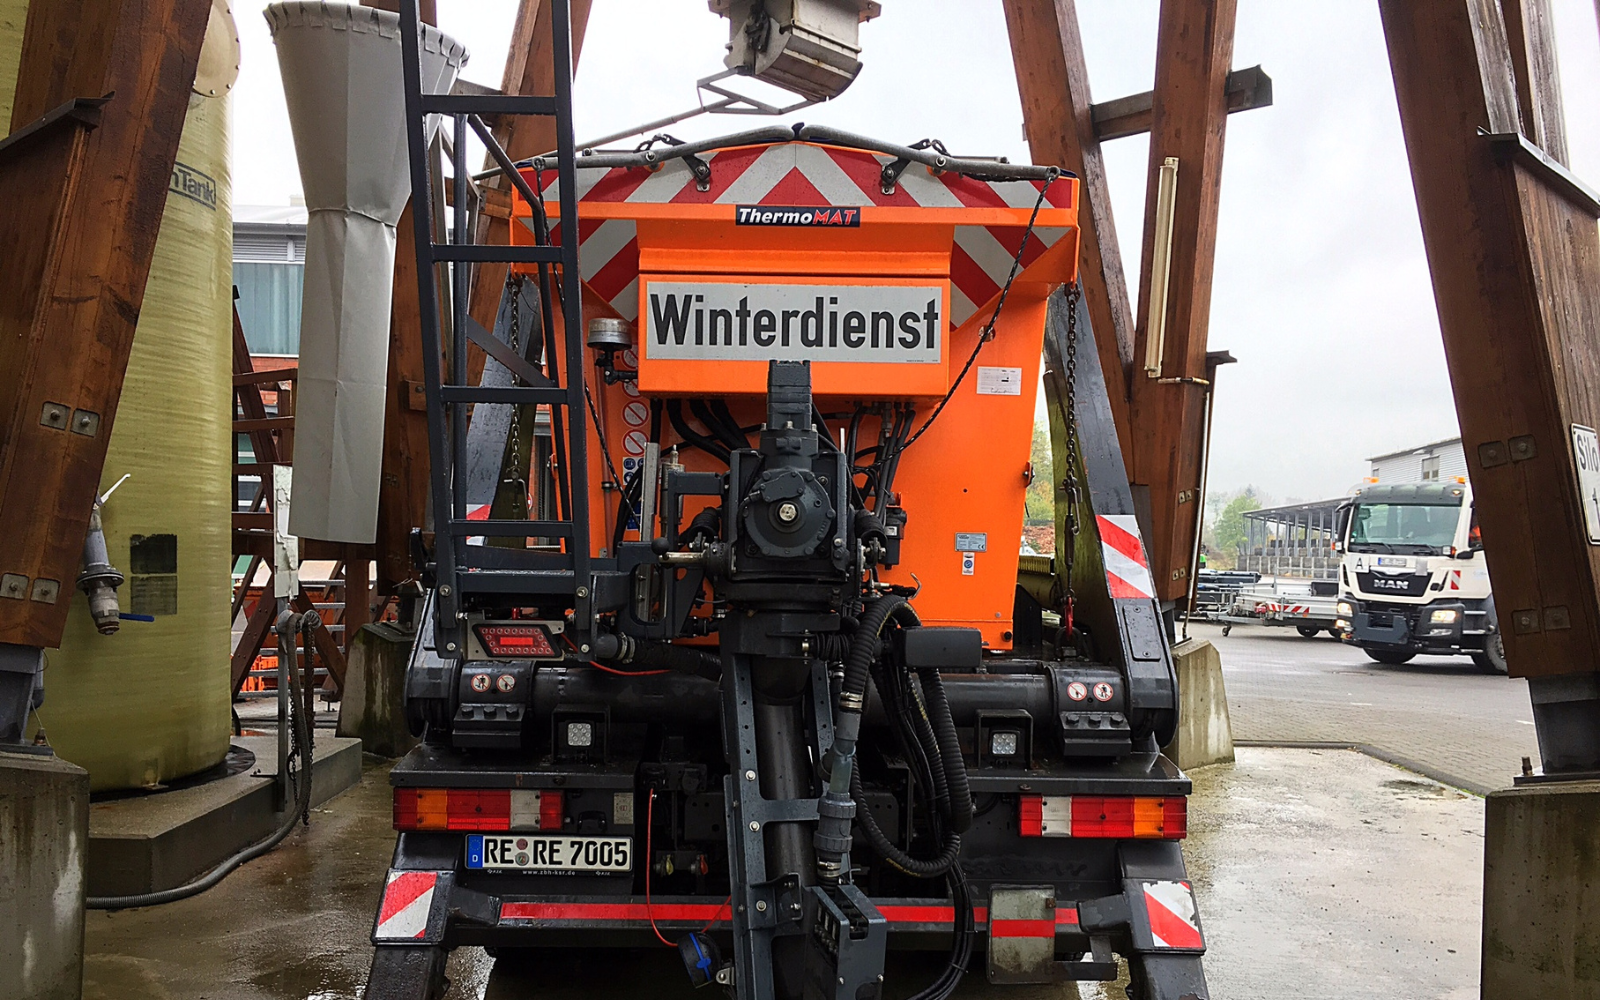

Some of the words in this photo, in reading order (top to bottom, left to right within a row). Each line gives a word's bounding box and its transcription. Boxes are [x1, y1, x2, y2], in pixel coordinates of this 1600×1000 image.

[739, 208, 857, 225] ThermoMAT
[650, 293, 938, 349] Winterdienst
[1577, 434, 1599, 472] Silo
[1355, 557, 1364, 570] A
[1373, 579, 1409, 590] MAN
[472, 854, 478, 862] D
[484, 838, 514, 864] RE
[533, 839, 563, 865] RE
[570, 840, 628, 867] 7005
